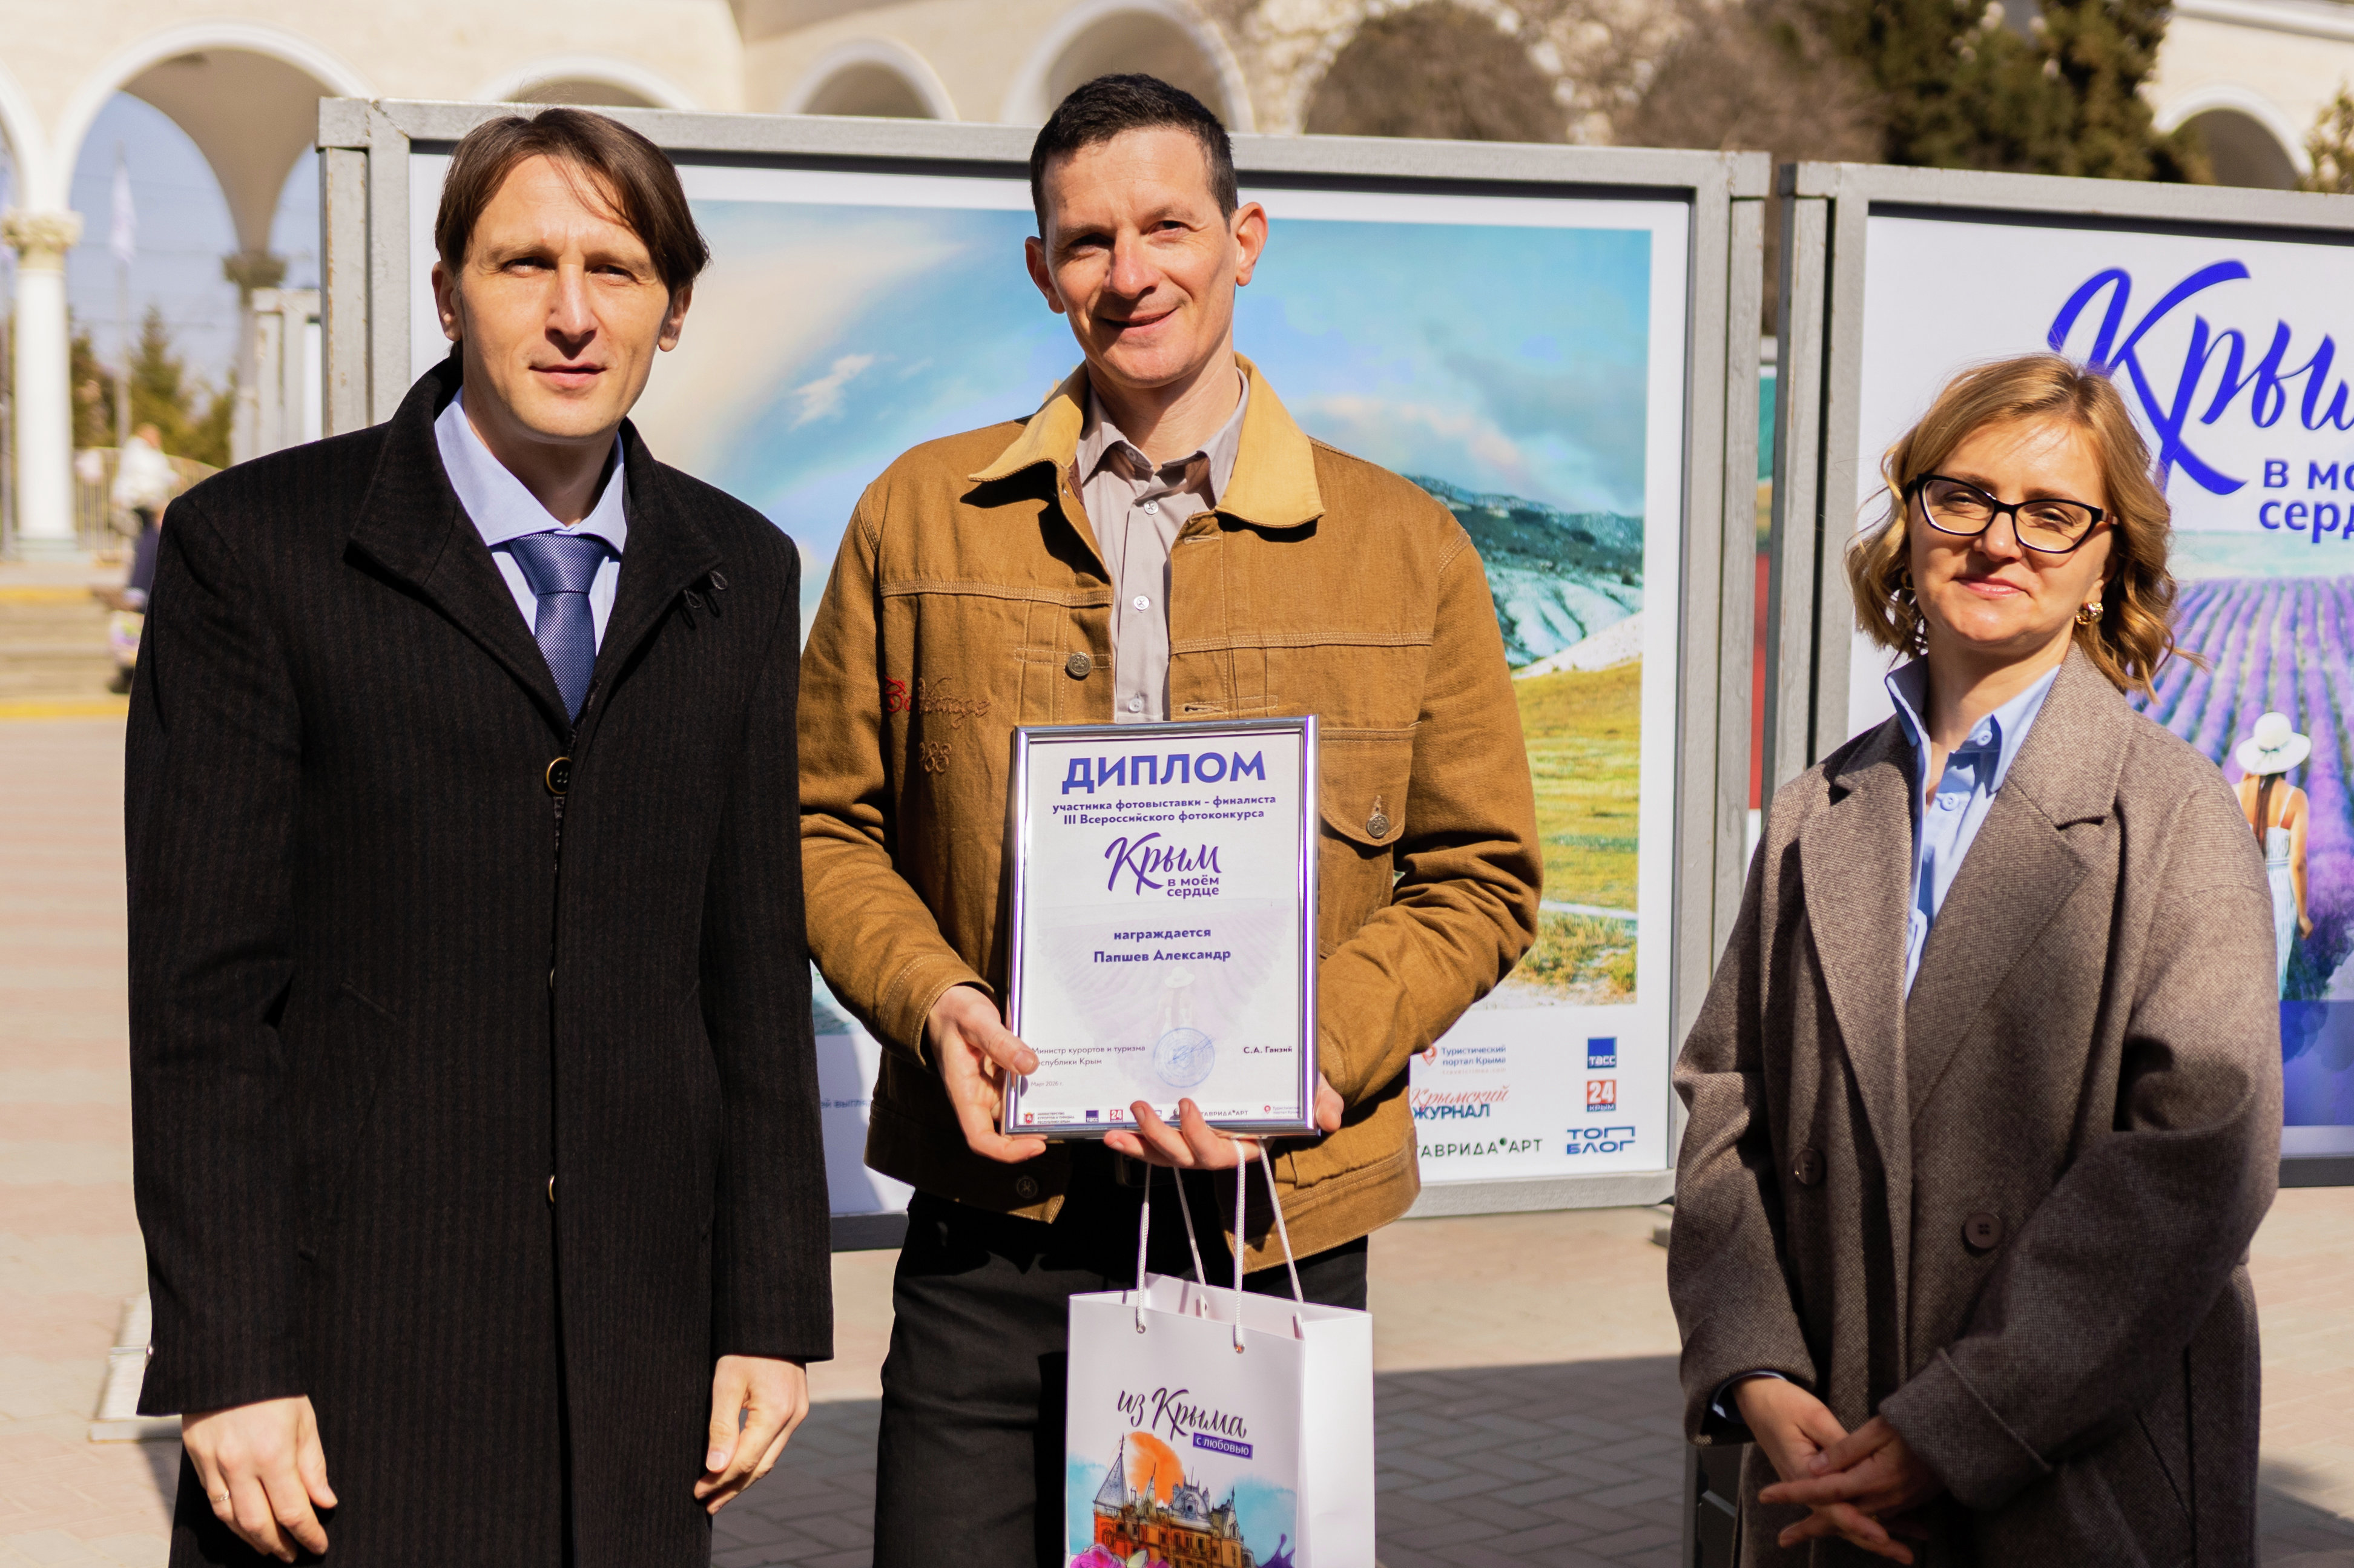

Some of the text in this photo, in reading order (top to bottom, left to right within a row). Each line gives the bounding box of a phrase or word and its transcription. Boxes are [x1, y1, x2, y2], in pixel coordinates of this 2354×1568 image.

[2048, 259, 2354, 495] Кры
[2263, 459, 2289, 489] в
[1061, 751, 1266, 795] ДИПЛОМ
[1052, 801, 1112, 814] участника
[1115, 799, 1201, 812] фотовыставки
[1213, 795, 1276, 808] финалиста
[1080, 812, 1175, 826] Всероссийского
[1178, 809, 1264, 823] фотоконкурса
[1104, 832, 1222, 896] Крым
[1181, 875, 1219, 886] моём
[1167, 887, 1219, 899] сердце
[1113, 929, 1211, 943] награждается
[1093, 949, 1231, 963] Папшев Александр
[1441, 1044, 1506, 1056] Туристический
[1038, 1058, 1102, 1068] спублики Крым
[1443, 1056, 1506, 1067] портал Крыма
[1411, 1084, 1511, 1112] Крымский
[1589, 1081, 1614, 1103] 24
[1112, 1111, 1123, 1119] 24
[1413, 1104, 1491, 1119] ЖУРНАЛ
[1567, 1126, 1635, 1139] ТОП
[1567, 1140, 1635, 1155] БЛОГ
[1118, 1388, 1247, 1442] из Крыма
[1196, 1437, 1250, 1456] с любовью
